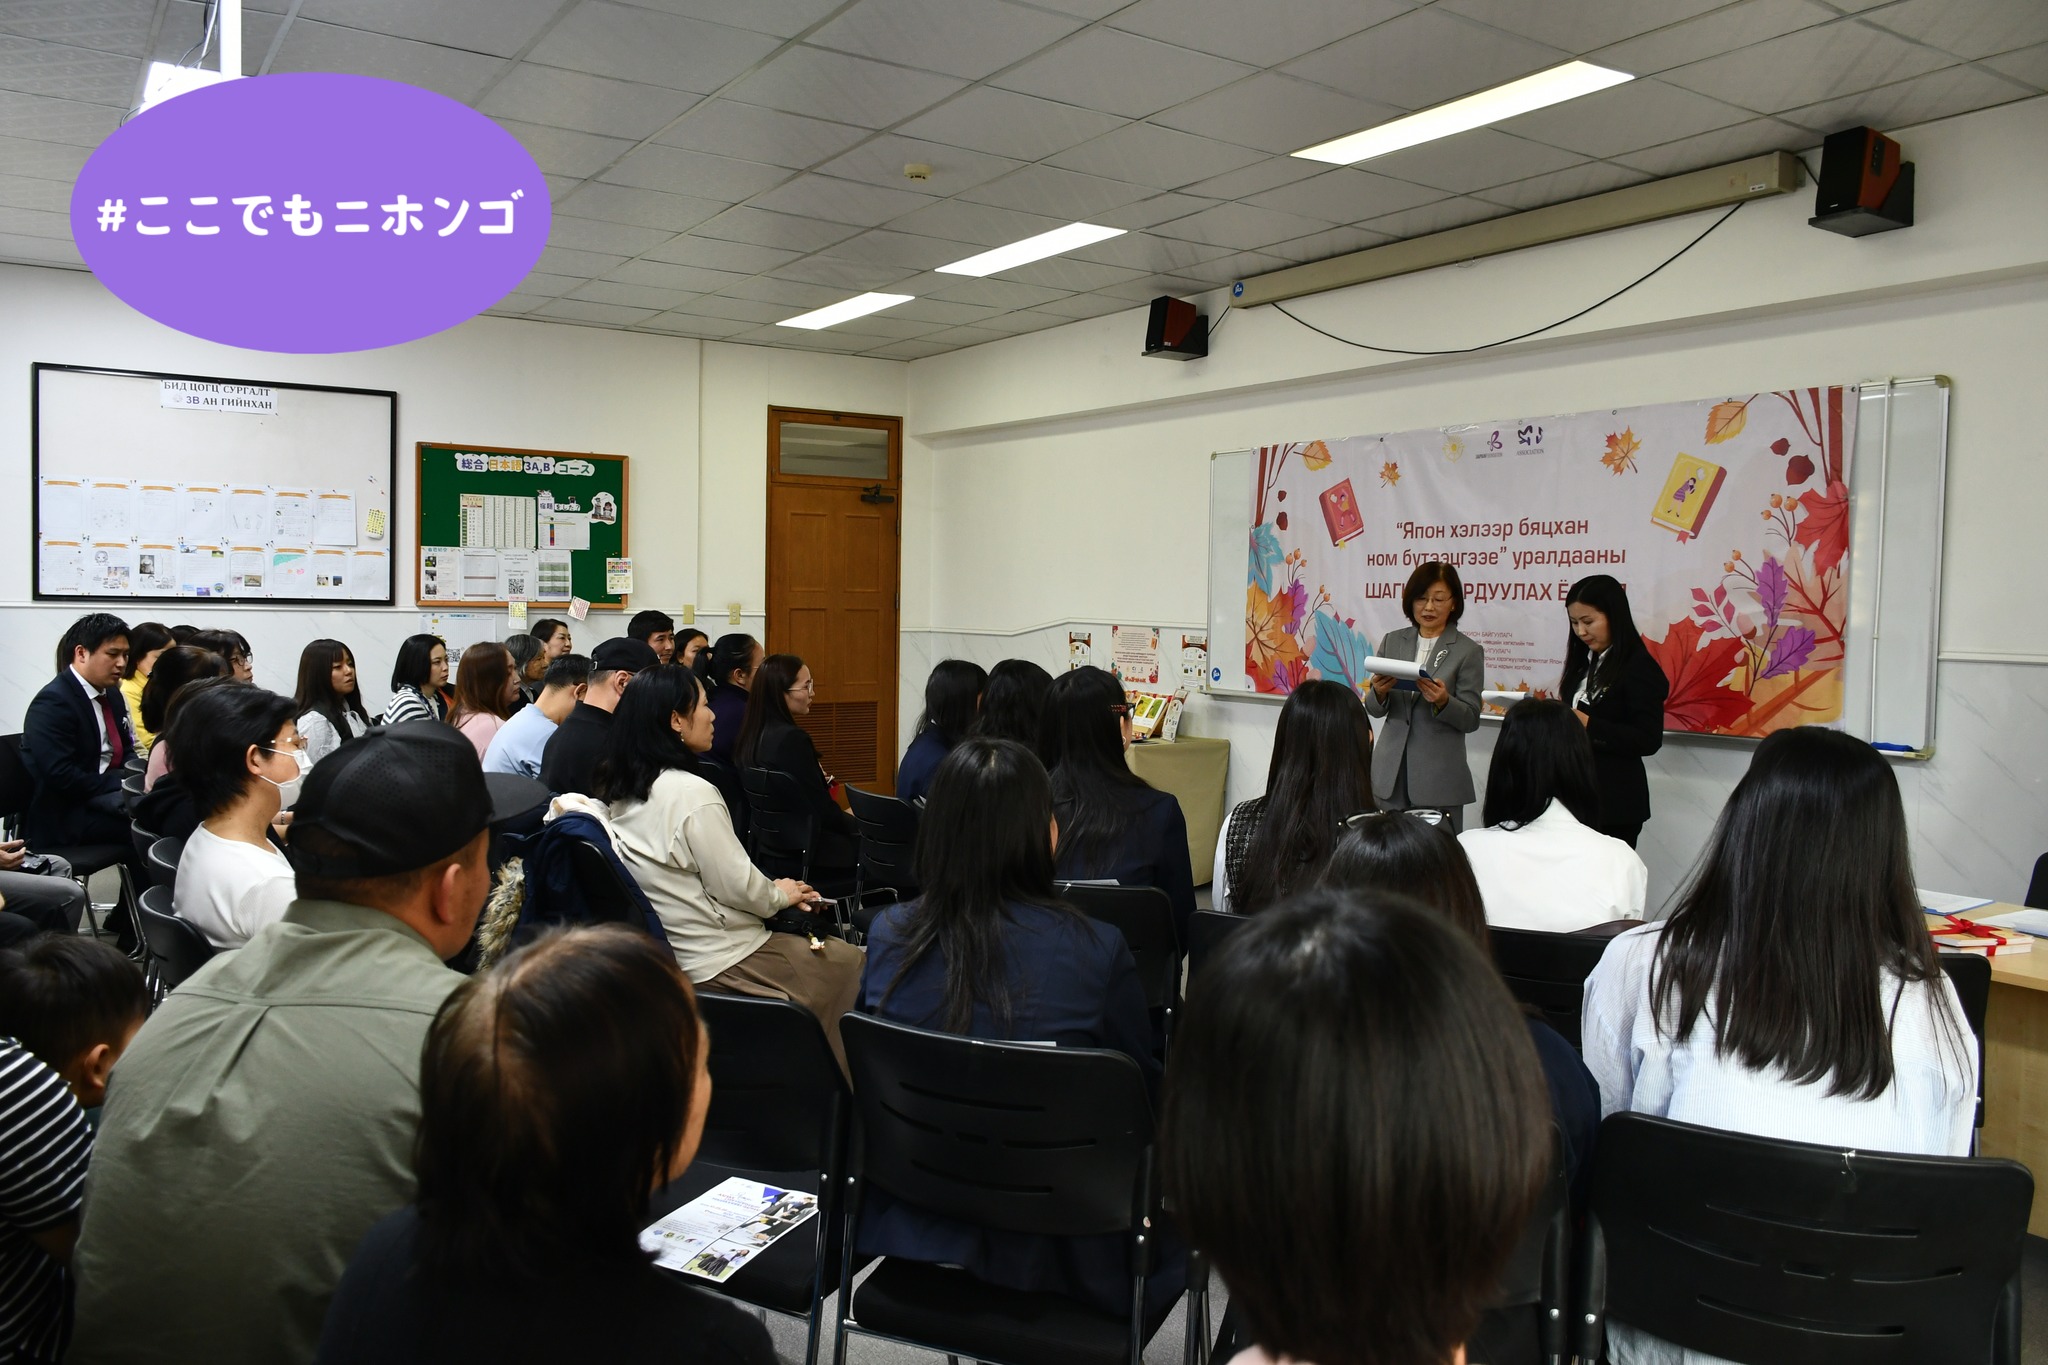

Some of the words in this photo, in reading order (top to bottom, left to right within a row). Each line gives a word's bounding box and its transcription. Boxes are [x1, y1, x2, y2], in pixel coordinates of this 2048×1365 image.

[164, 381, 188, 392] БИД
[189, 383, 220, 394] ЦОГЦ
[223, 385, 271, 397] СУРГАЛТ
[202, 397, 218, 406] АН
[221, 397, 273, 410] ГИЙНХАН
[489, 459, 522, 471] 日本語
[559, 464, 590, 474] コース
[1450, 522, 1513, 541] хэлээр
[1519, 518, 1589, 538] бяцхан
[1367, 552, 1398, 566] ном
[1512, 548, 1626, 570] уралдааны
[1463, 582, 1552, 604] РДУУЛАХ
